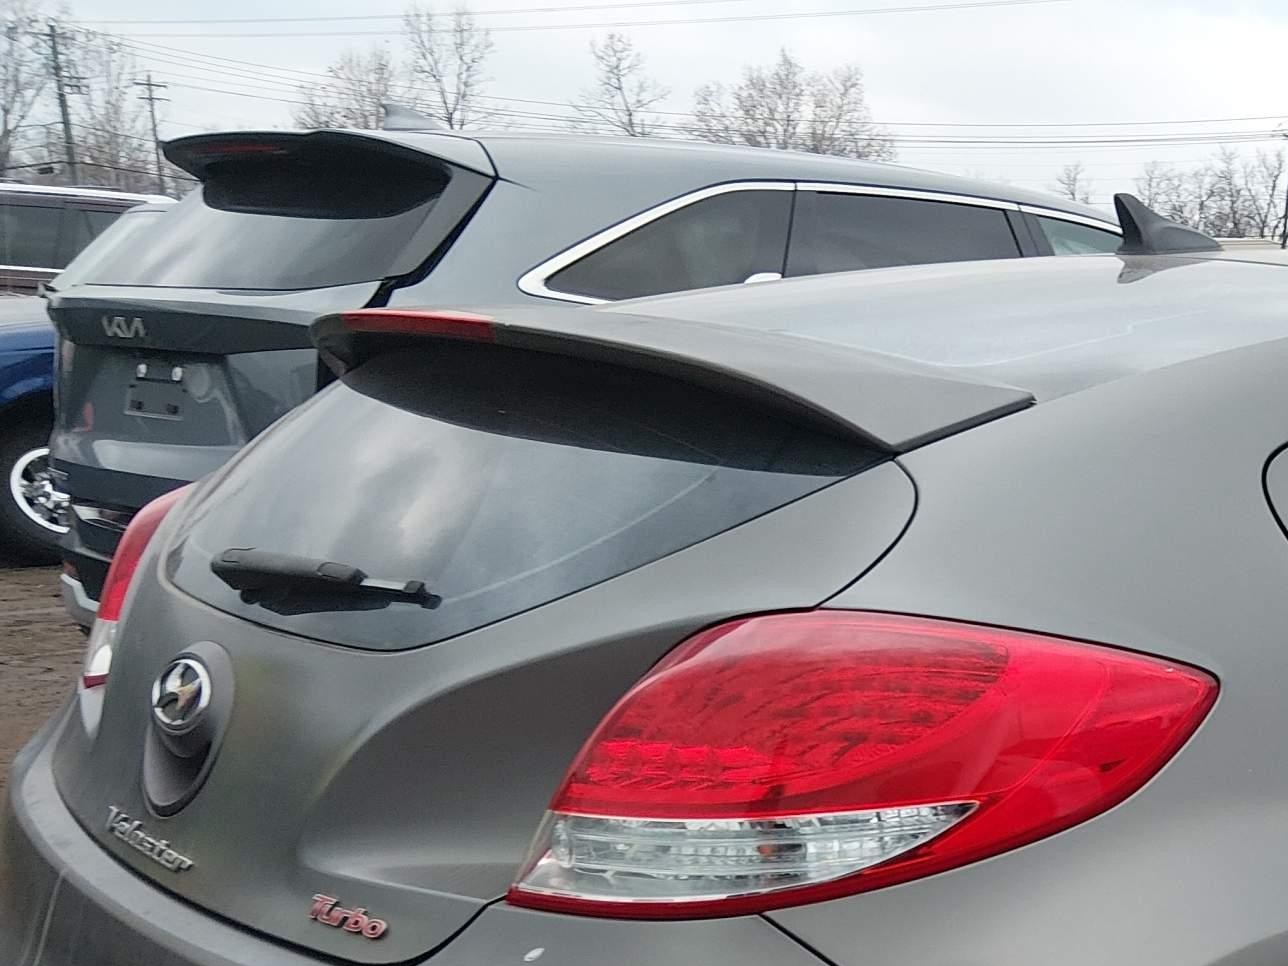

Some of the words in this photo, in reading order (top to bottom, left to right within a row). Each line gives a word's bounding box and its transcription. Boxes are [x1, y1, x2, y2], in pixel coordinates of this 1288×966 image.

[101, 316, 145, 338] KIA
[106, 805, 193, 872] Veloster
[308, 893, 388, 938] Turbo
